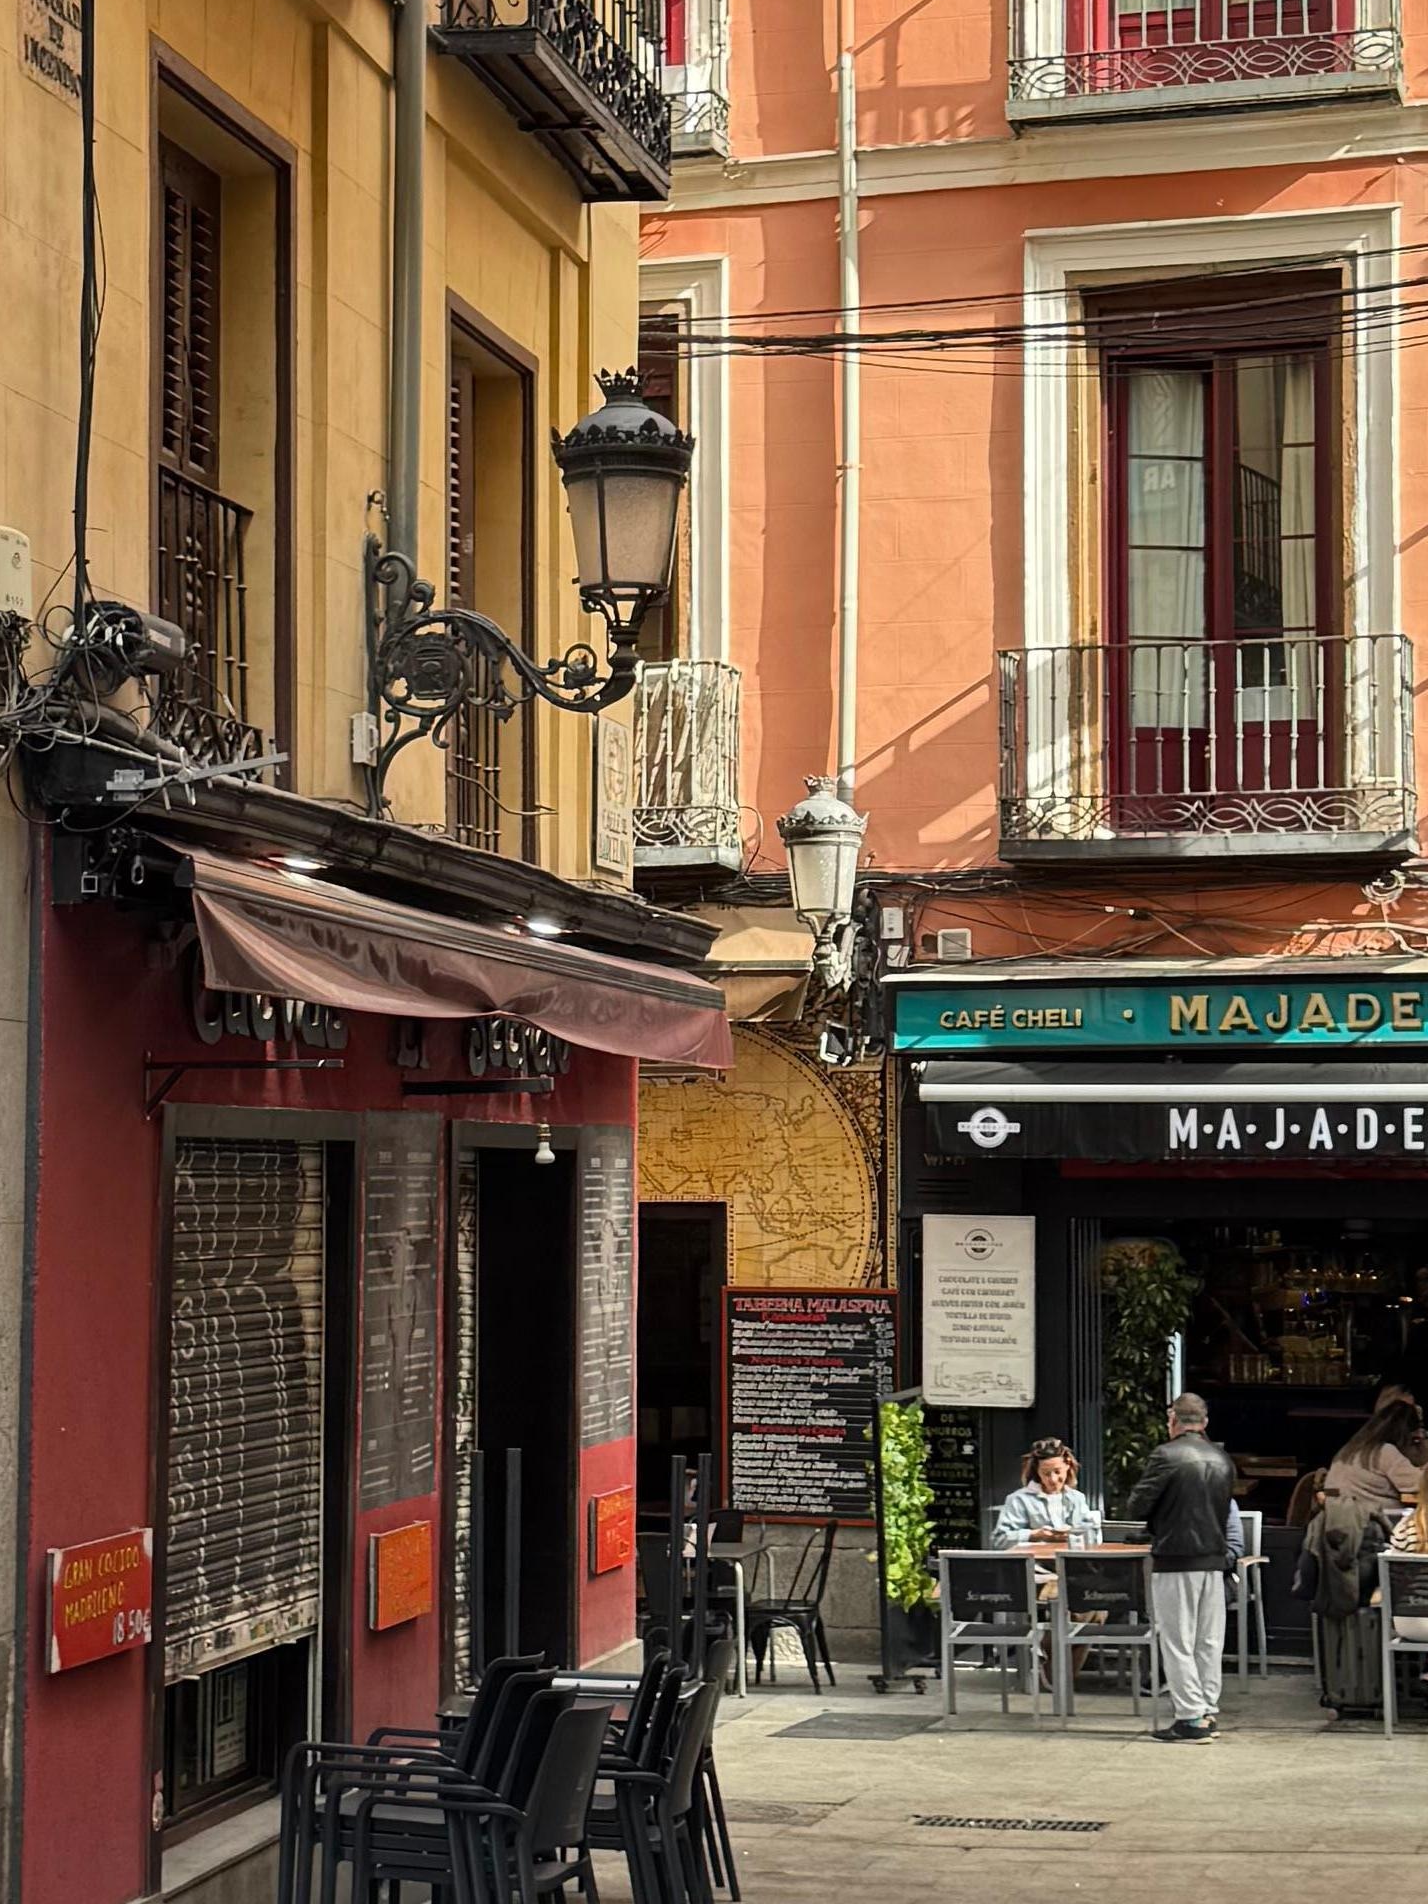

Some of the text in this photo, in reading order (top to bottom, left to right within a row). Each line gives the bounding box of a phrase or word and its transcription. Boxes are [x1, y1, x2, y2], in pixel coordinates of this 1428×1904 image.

[940, 1003, 1004, 1030] CAFÉ
[1012, 1008, 1082, 1030] CHELI
[807, 1298, 892, 1314] MALASPINA
[64, 1558, 93, 1589] GRAN
